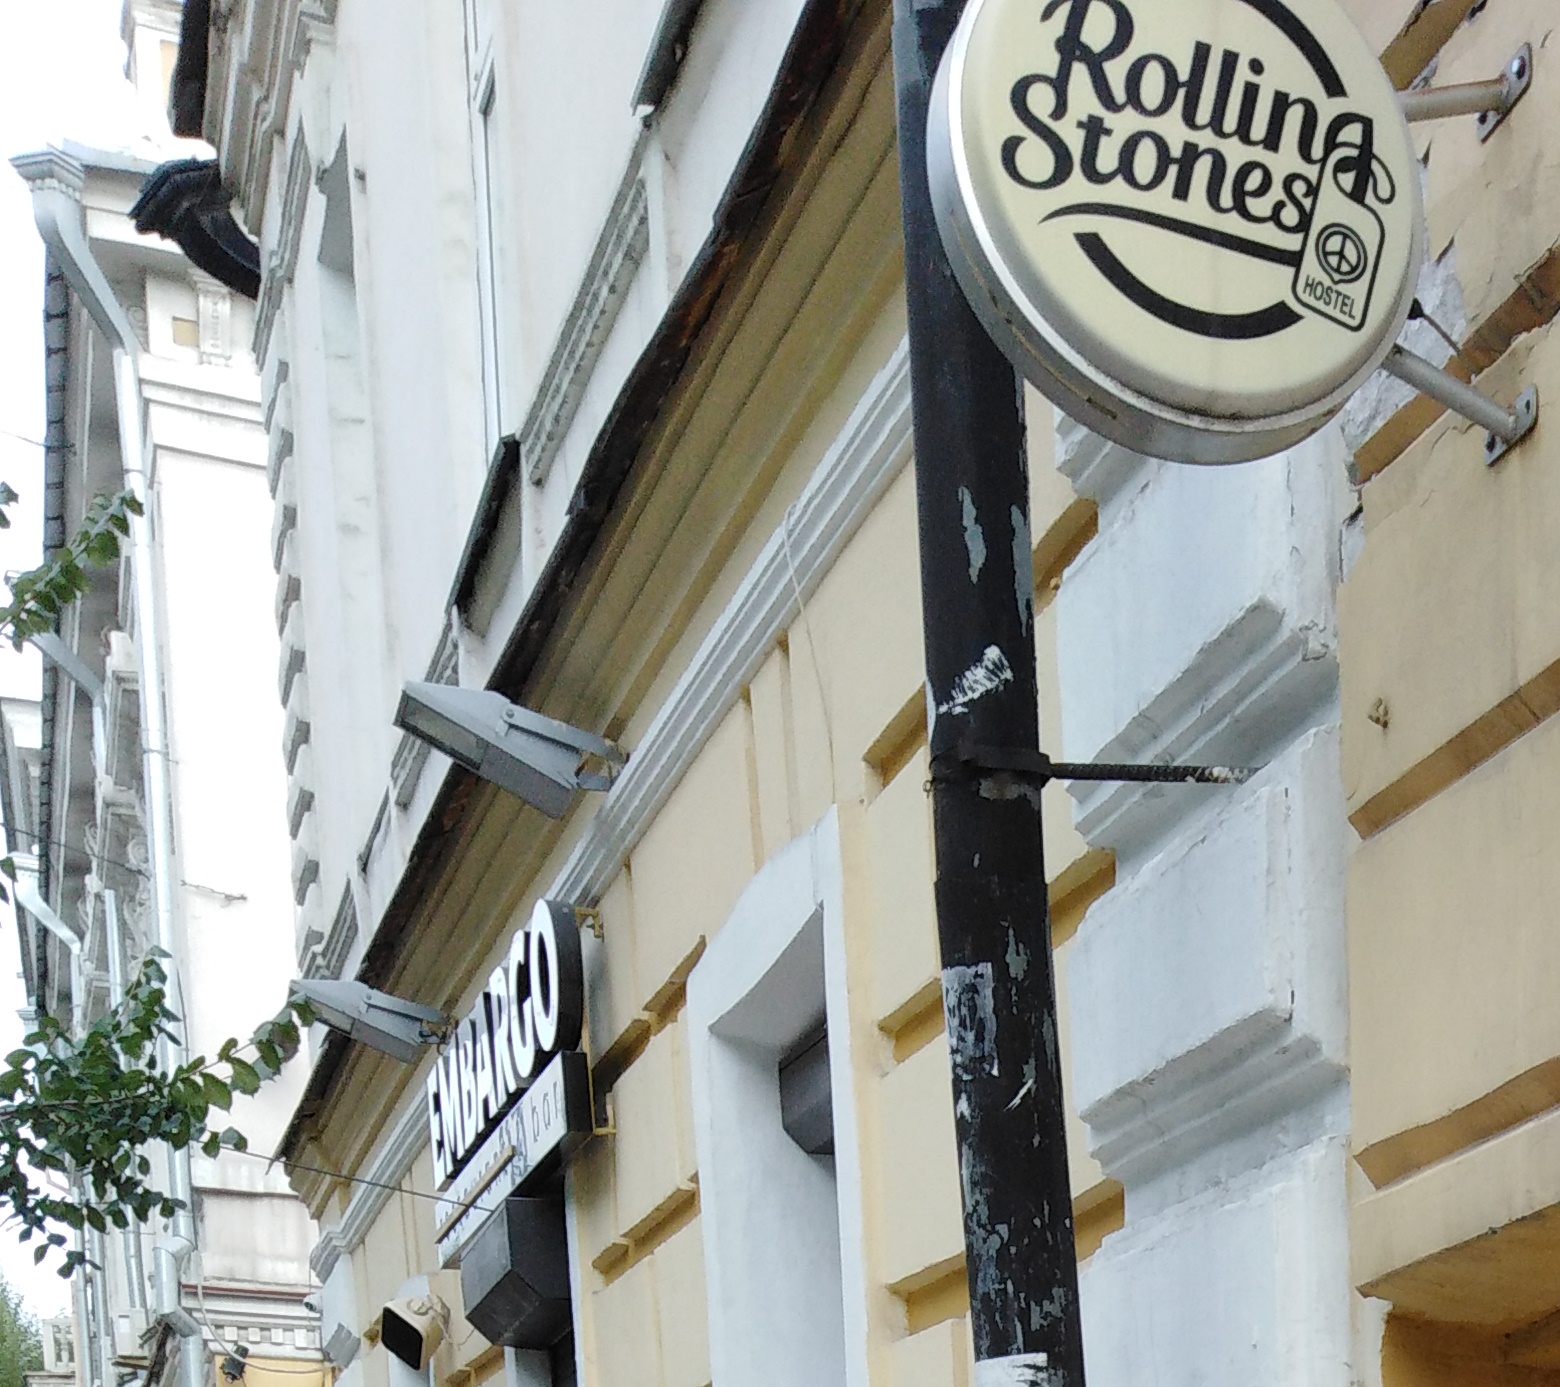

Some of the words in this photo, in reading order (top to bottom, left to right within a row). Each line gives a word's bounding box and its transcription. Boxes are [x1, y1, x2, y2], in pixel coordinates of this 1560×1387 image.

[1001, 73, 1318, 234] Stones
[1040, 0, 1374, 204] Rolling
[1303, 274, 1356, 320] HOSTEL
[427, 898, 559, 1191] EMBARCO
